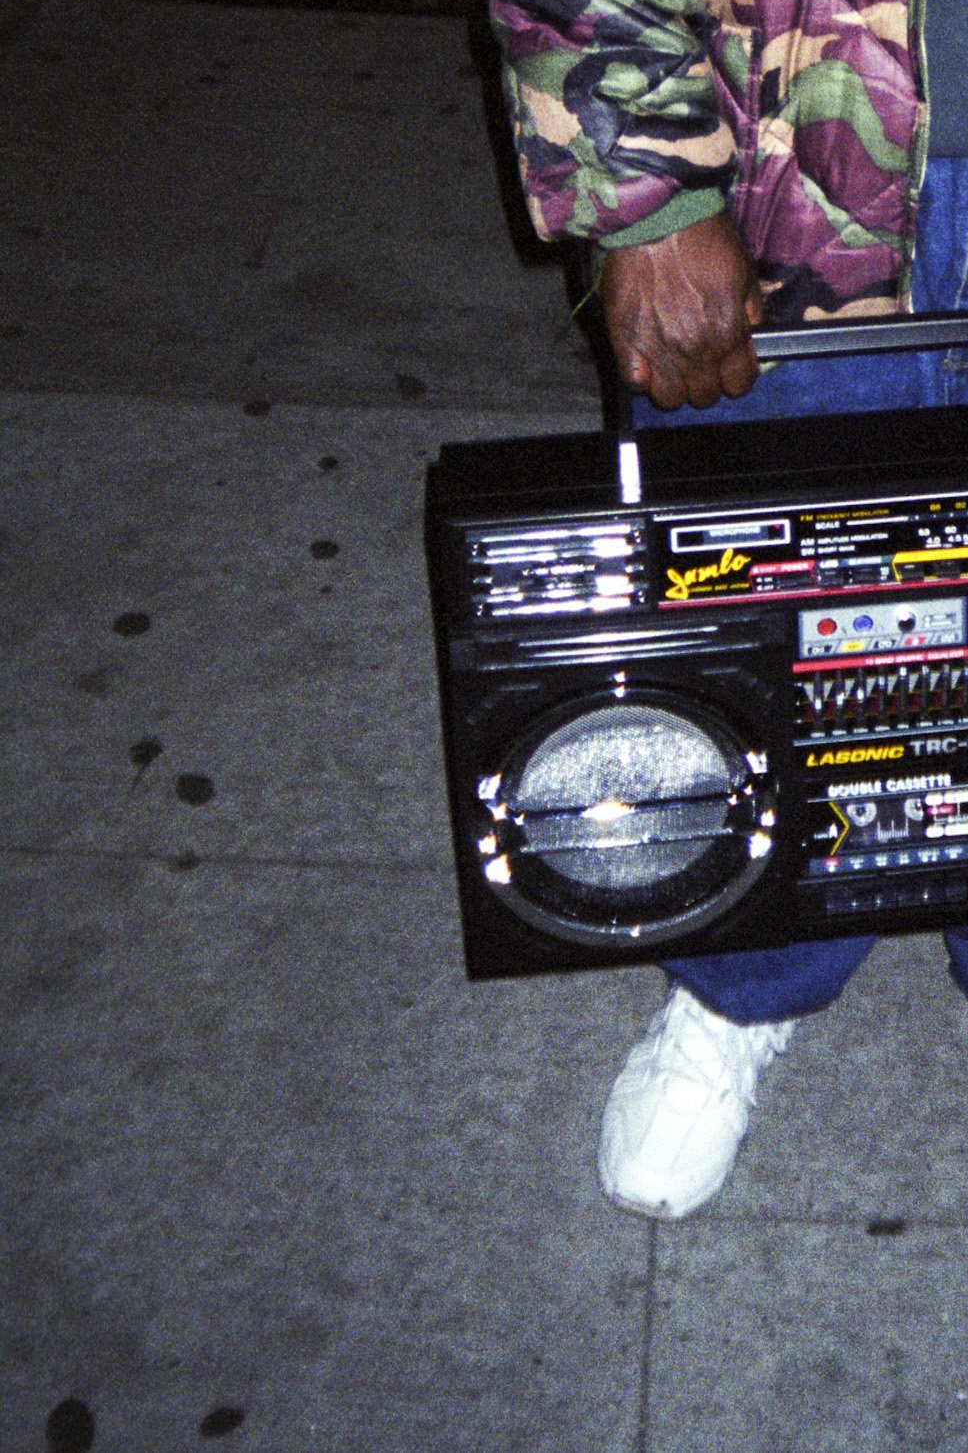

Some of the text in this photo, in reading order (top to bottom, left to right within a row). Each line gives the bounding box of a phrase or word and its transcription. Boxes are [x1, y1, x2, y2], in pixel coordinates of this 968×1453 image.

[955, 501, 967, 509] 92
[926, 536, 941, 545] 4.0
[806, 745, 904, 766] LASONIC
[828, 774, 951, 798] DOUBLE CASSETTE
[828, 823, 838, 838] A
